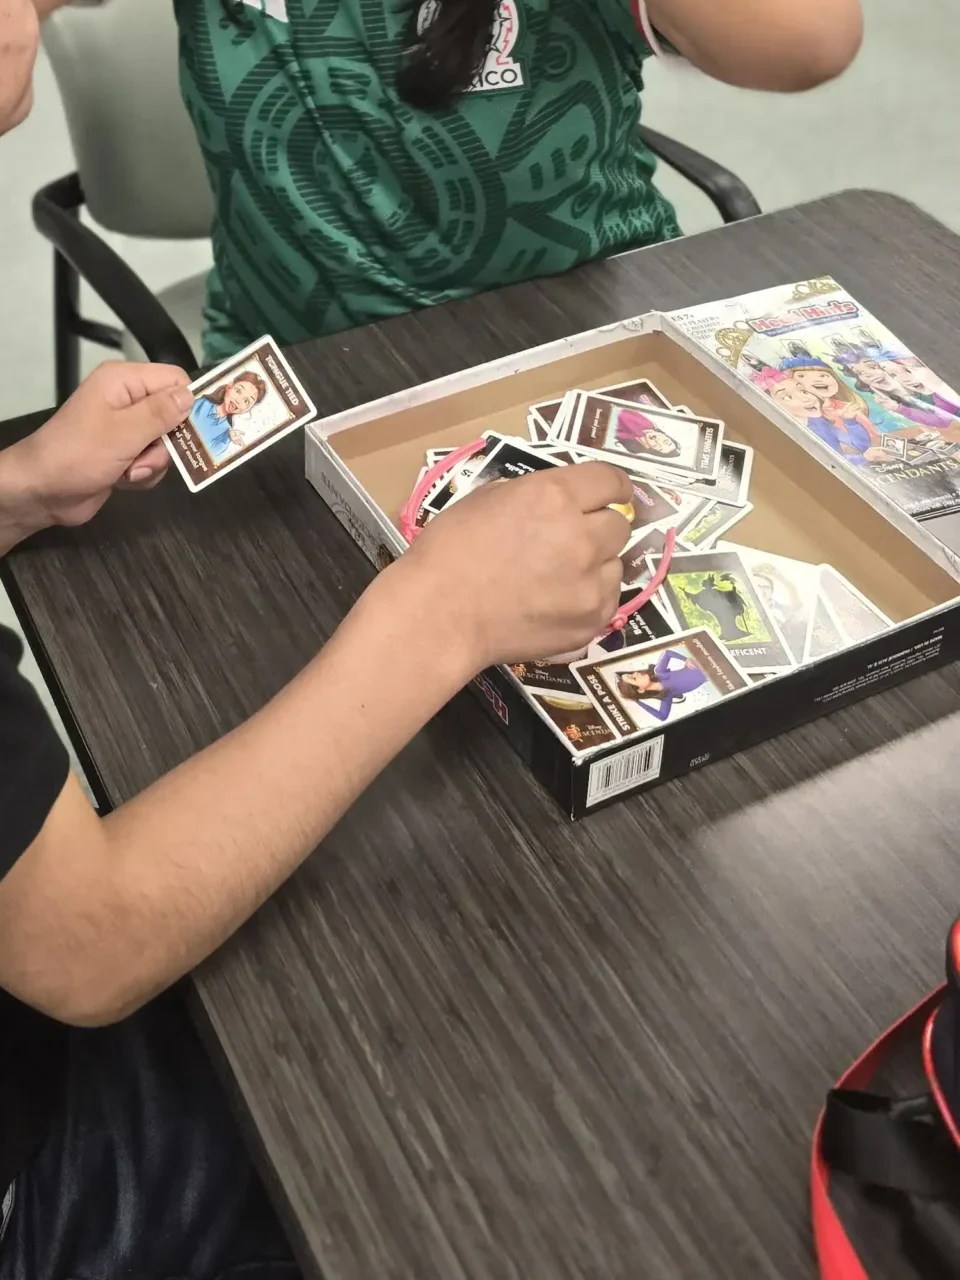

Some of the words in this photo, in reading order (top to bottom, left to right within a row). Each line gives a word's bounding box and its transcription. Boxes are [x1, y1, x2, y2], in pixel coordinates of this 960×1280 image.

[478, 67, 518, 88] ICO
[803, 300, 857, 320] Hints
[265, 354, 288, 388] TONGUE
[284, 387, 298, 406] TIED
[702, 427, 713, 452] SLEEPING
[700, 453, 709, 468] SPELL
[876, 459, 959, 486] CENDANTS
[628, 619, 642, 636] Ben
[730, 647, 768, 658] EFICENT
[706, 654, 722, 677] fashion
[586, 674, 607, 695] POSE
[608, 703, 630, 731] STRIKE
